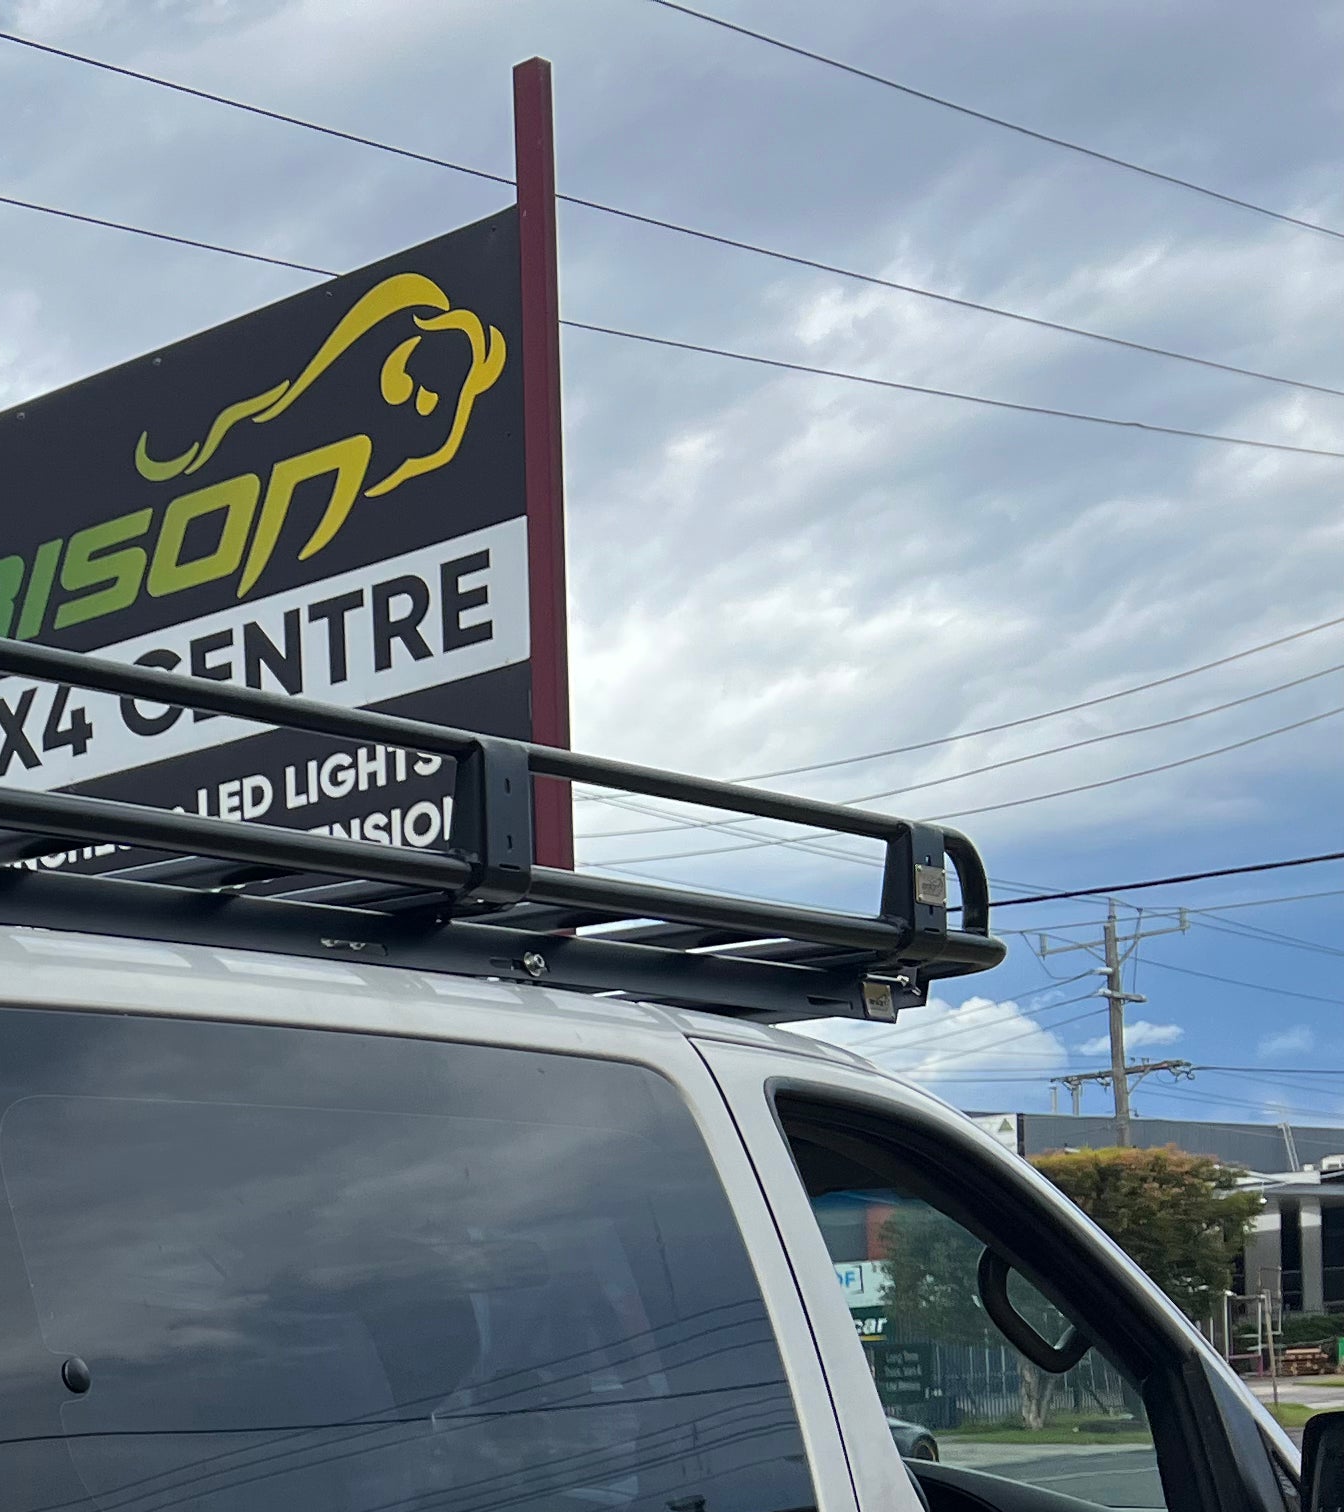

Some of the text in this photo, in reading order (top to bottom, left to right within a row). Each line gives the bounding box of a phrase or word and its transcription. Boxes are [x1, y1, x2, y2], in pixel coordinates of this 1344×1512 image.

[119, 548, 494, 737] CENTRE
[196, 744, 443, 821] LED LIGHTS
